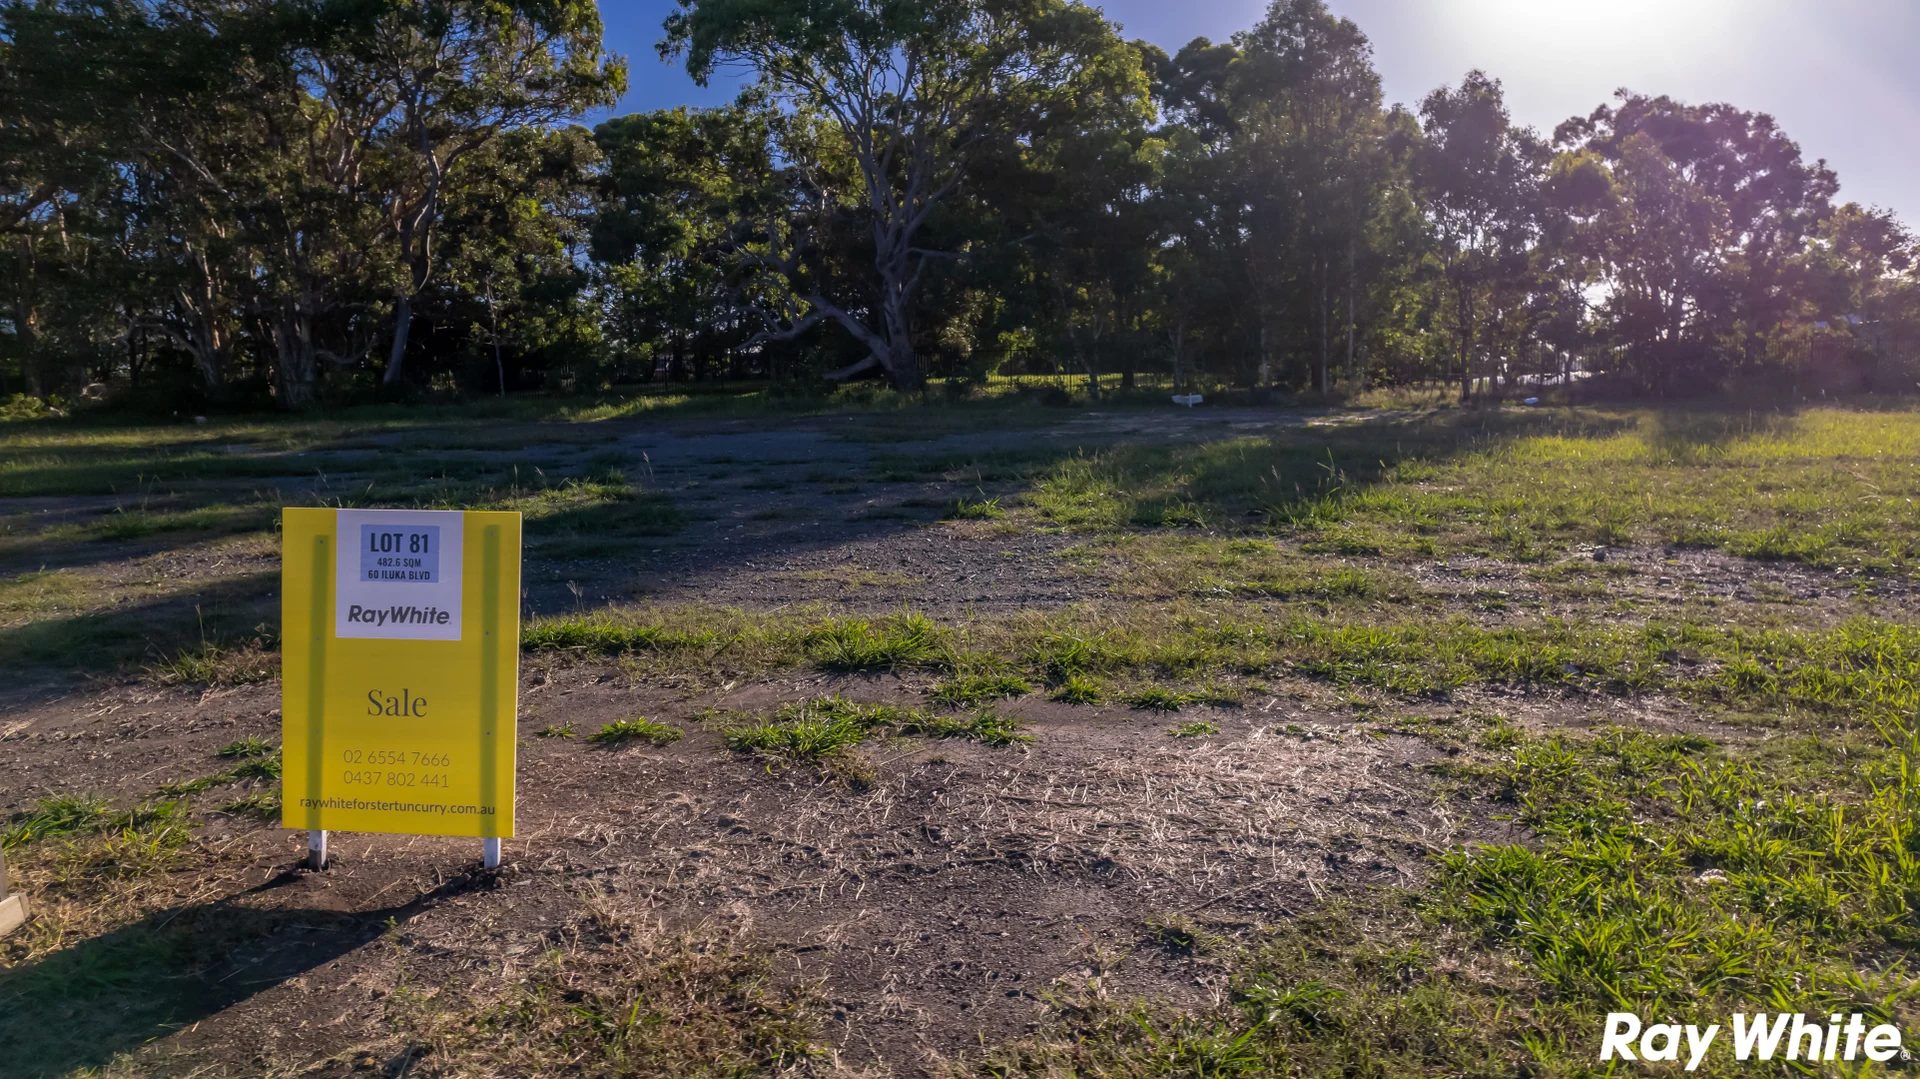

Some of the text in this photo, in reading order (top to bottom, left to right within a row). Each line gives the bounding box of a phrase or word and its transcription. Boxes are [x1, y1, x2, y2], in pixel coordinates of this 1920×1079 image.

[370, 533, 429, 554] LOT 81
[377, 558, 421, 568] 482.6 SQM
[368, 570, 430, 580] 60 ILUKA BLVD
[367, 688, 428, 718] Sale
[343, 749, 450, 767] 02 6554 7666
[343, 770, 449, 788] 0437 802 441
[299, 797, 495, 815] raywhiteforstertuncurry.com.au
